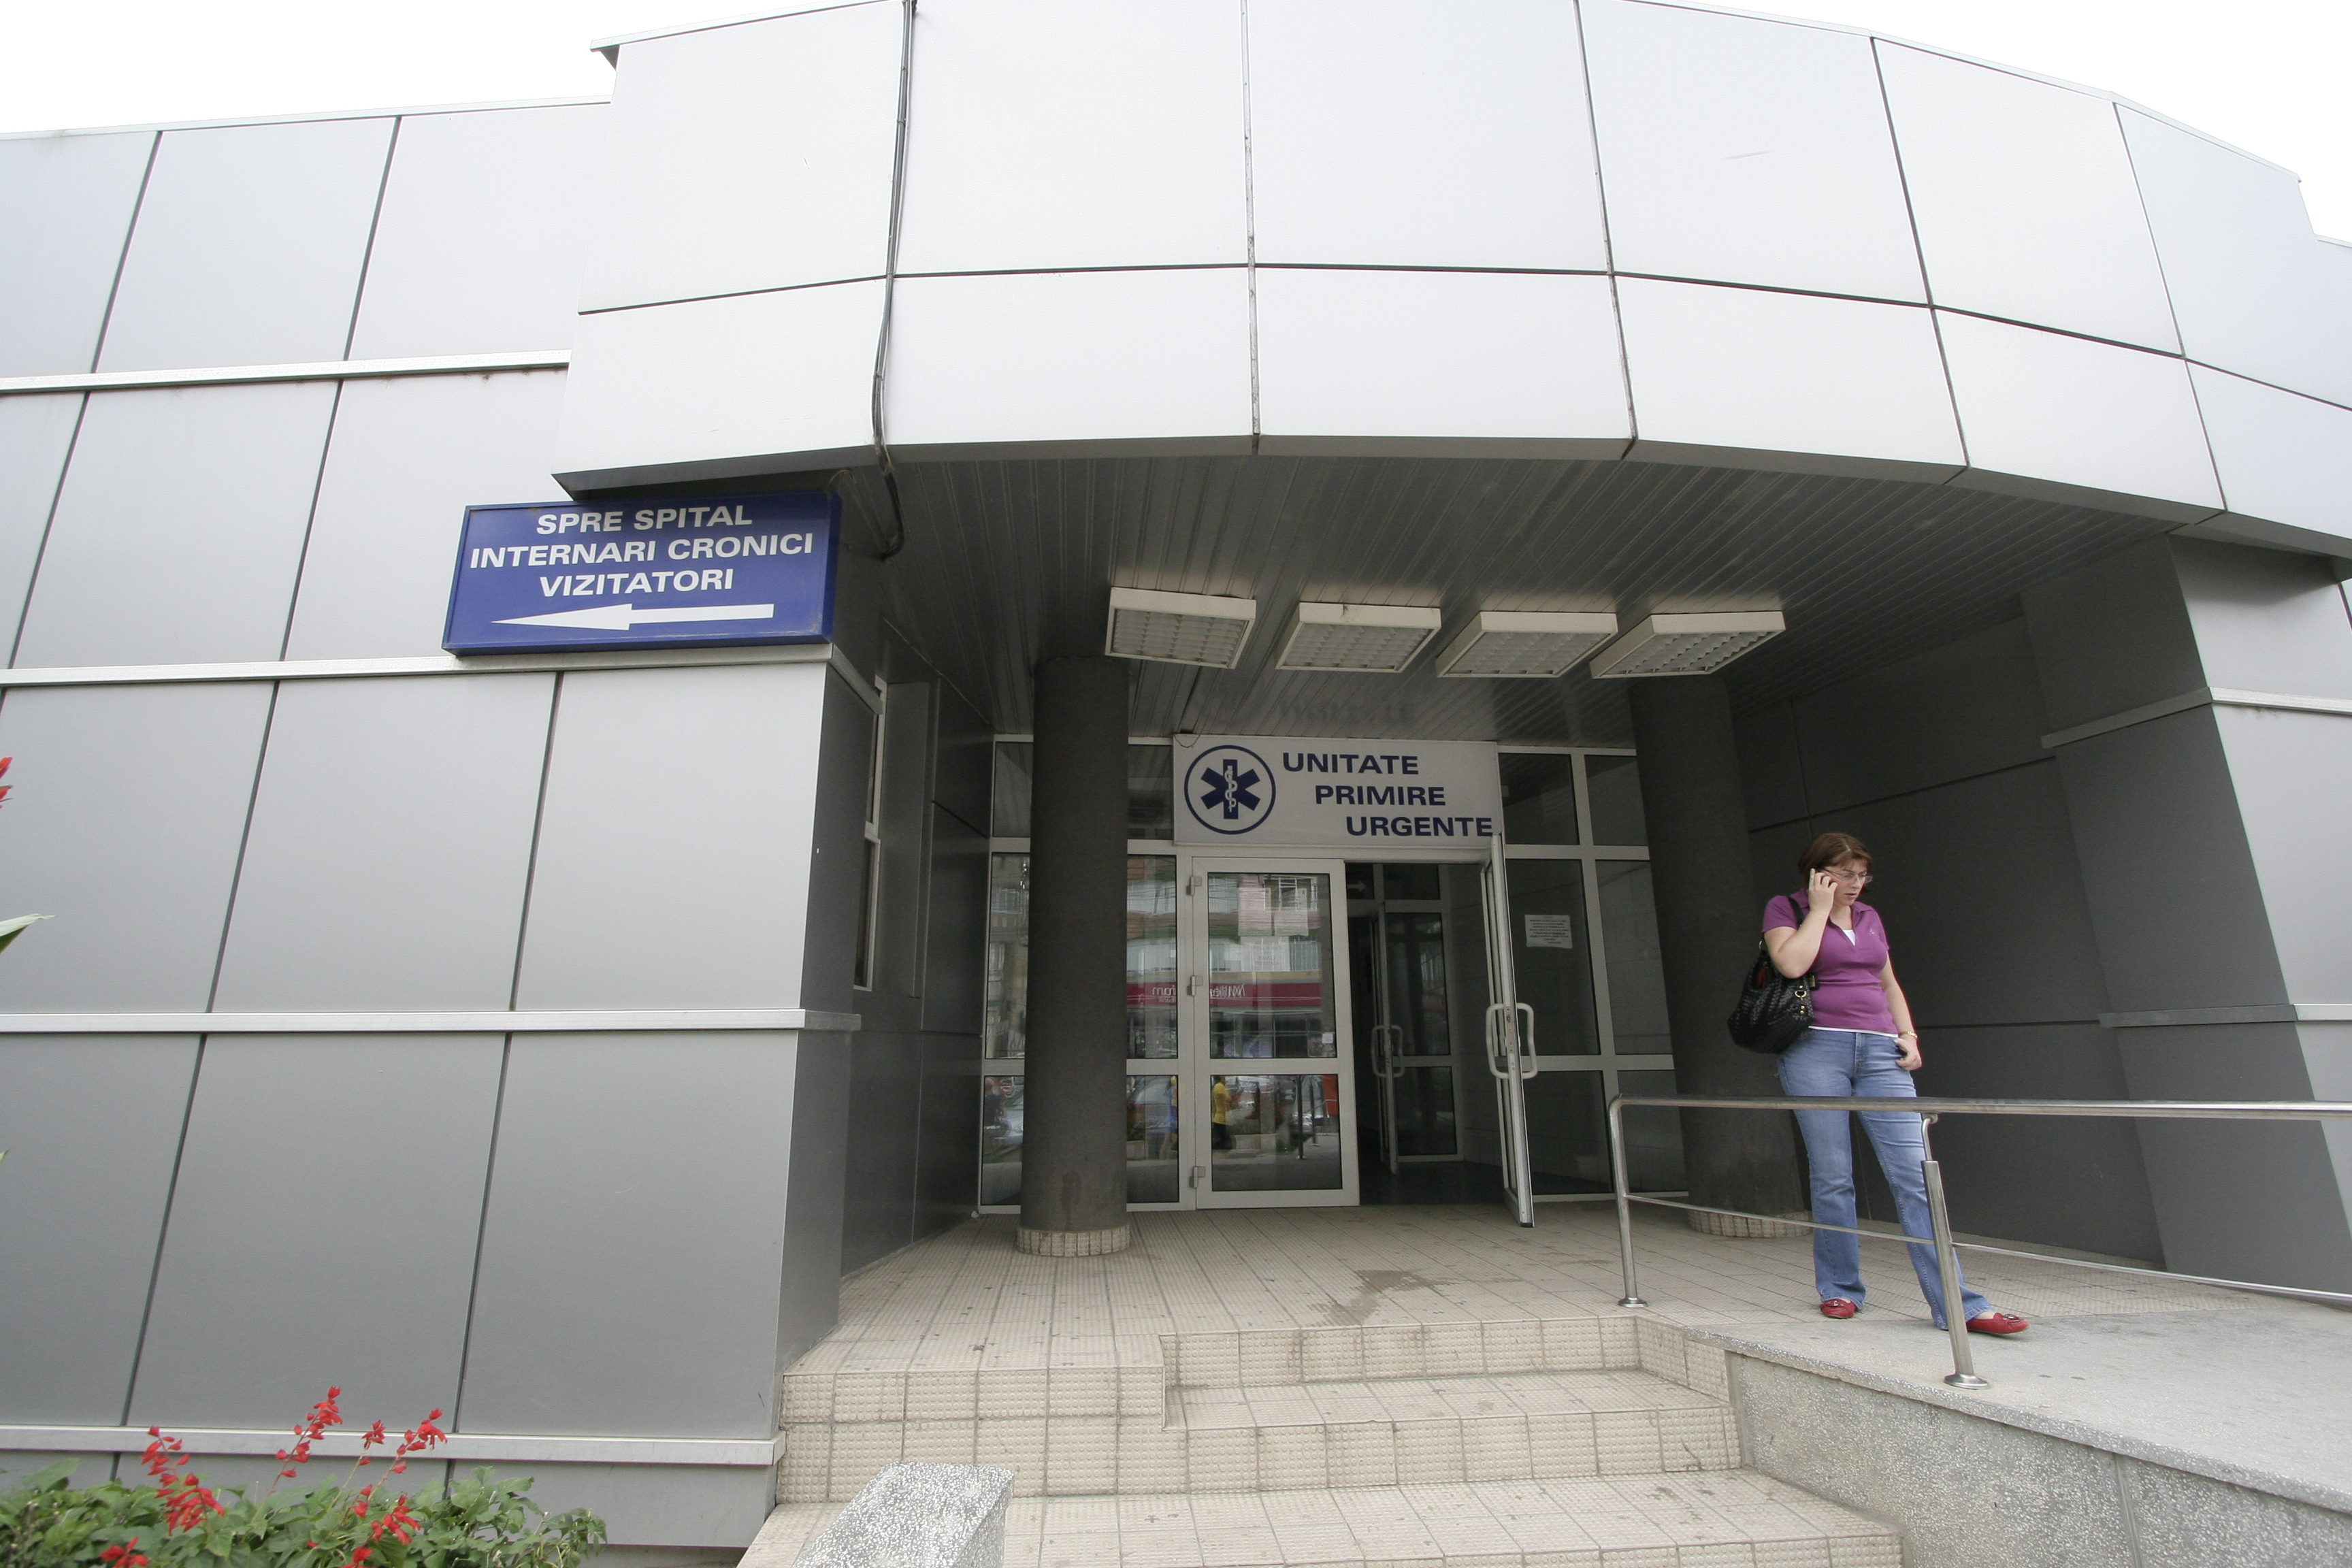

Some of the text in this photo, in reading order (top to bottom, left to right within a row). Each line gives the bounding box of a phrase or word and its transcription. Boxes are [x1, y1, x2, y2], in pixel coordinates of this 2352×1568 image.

[536, 505, 752, 534] SPRE SPITAL
[470, 533, 813, 568] INTERNARI CRONICI
[540, 568, 734, 597] VIZITATORI
[1283, 752, 1418, 774] UNITATE
[1315, 785, 1446, 806] PRIMIRE
[1346, 817, 1494, 837] URGENTE
